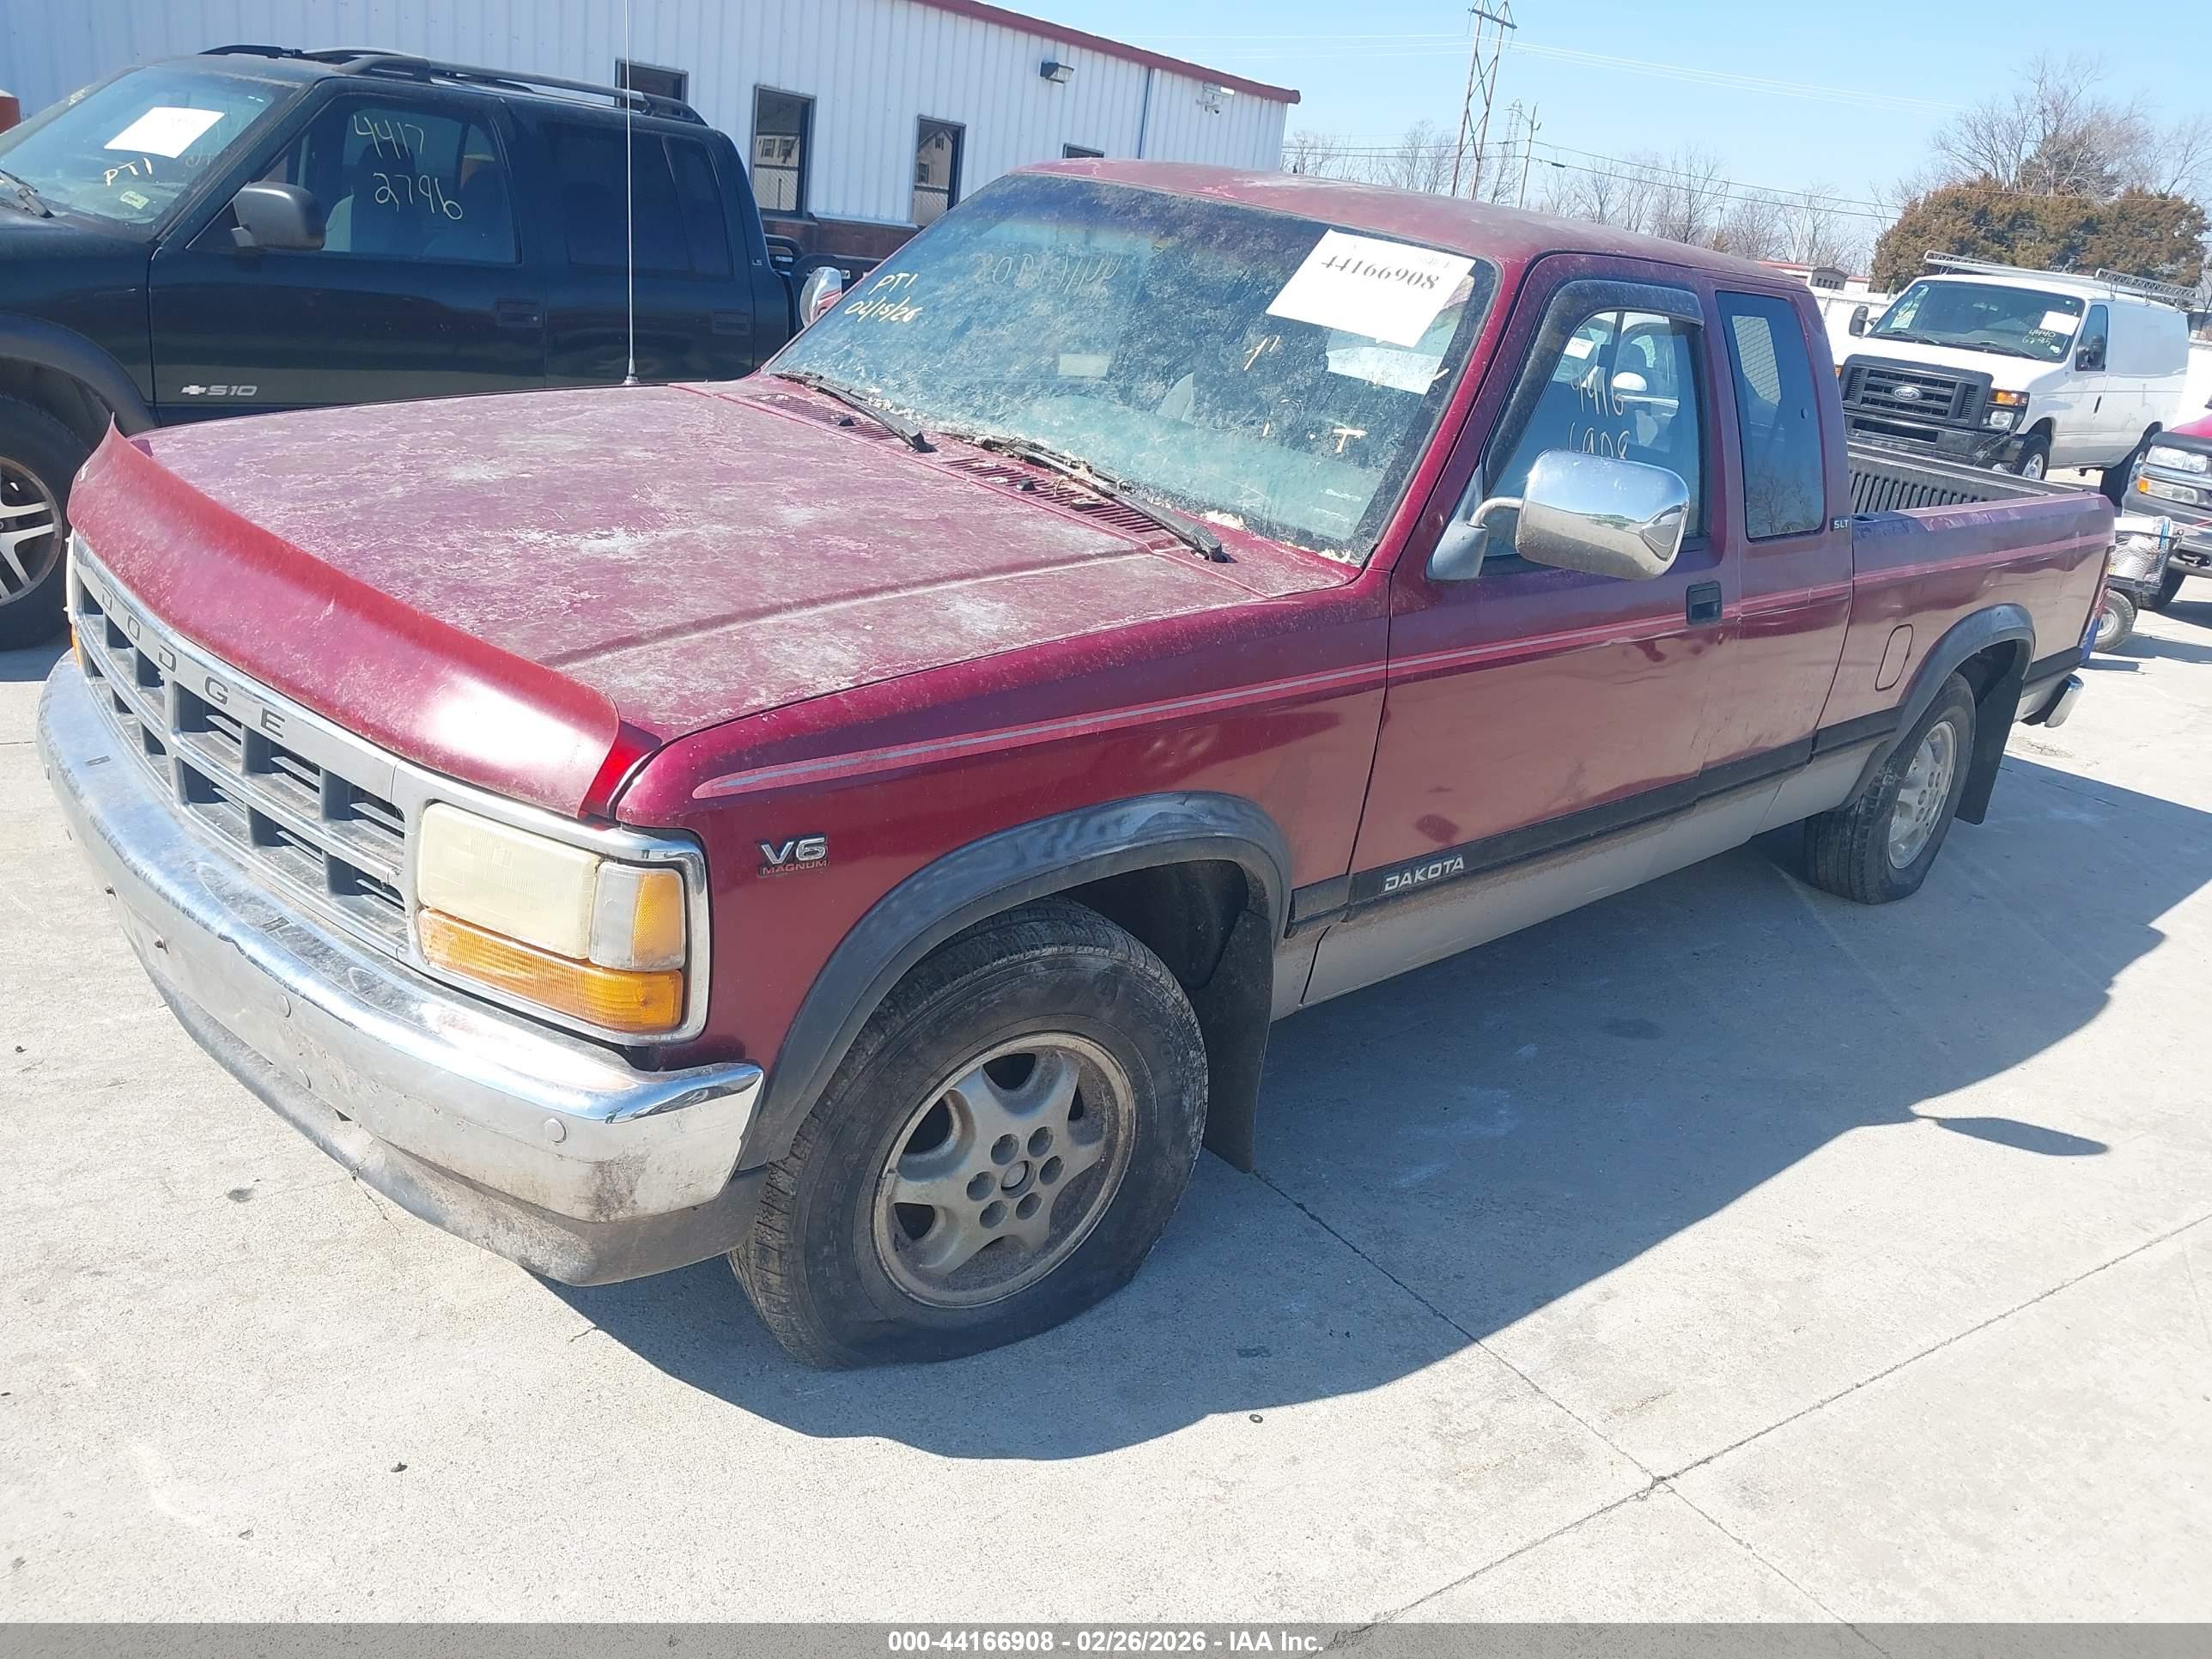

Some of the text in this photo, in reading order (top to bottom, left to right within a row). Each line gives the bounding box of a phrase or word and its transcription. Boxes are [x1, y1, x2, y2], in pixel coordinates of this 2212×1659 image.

[352, 114, 424, 160] 4417
[373, 172, 463, 220] 2796
[1321, 255, 1440, 290] 44166908
[207, 385, 258, 397] S10
[1833, 519, 1850, 529] SLT
[101, 584, 287, 740] DODGE
[761, 836, 826, 866] V6
[762, 859, 828, 875] MAGNUM
[1383, 856, 1465, 892] DAKOTA
